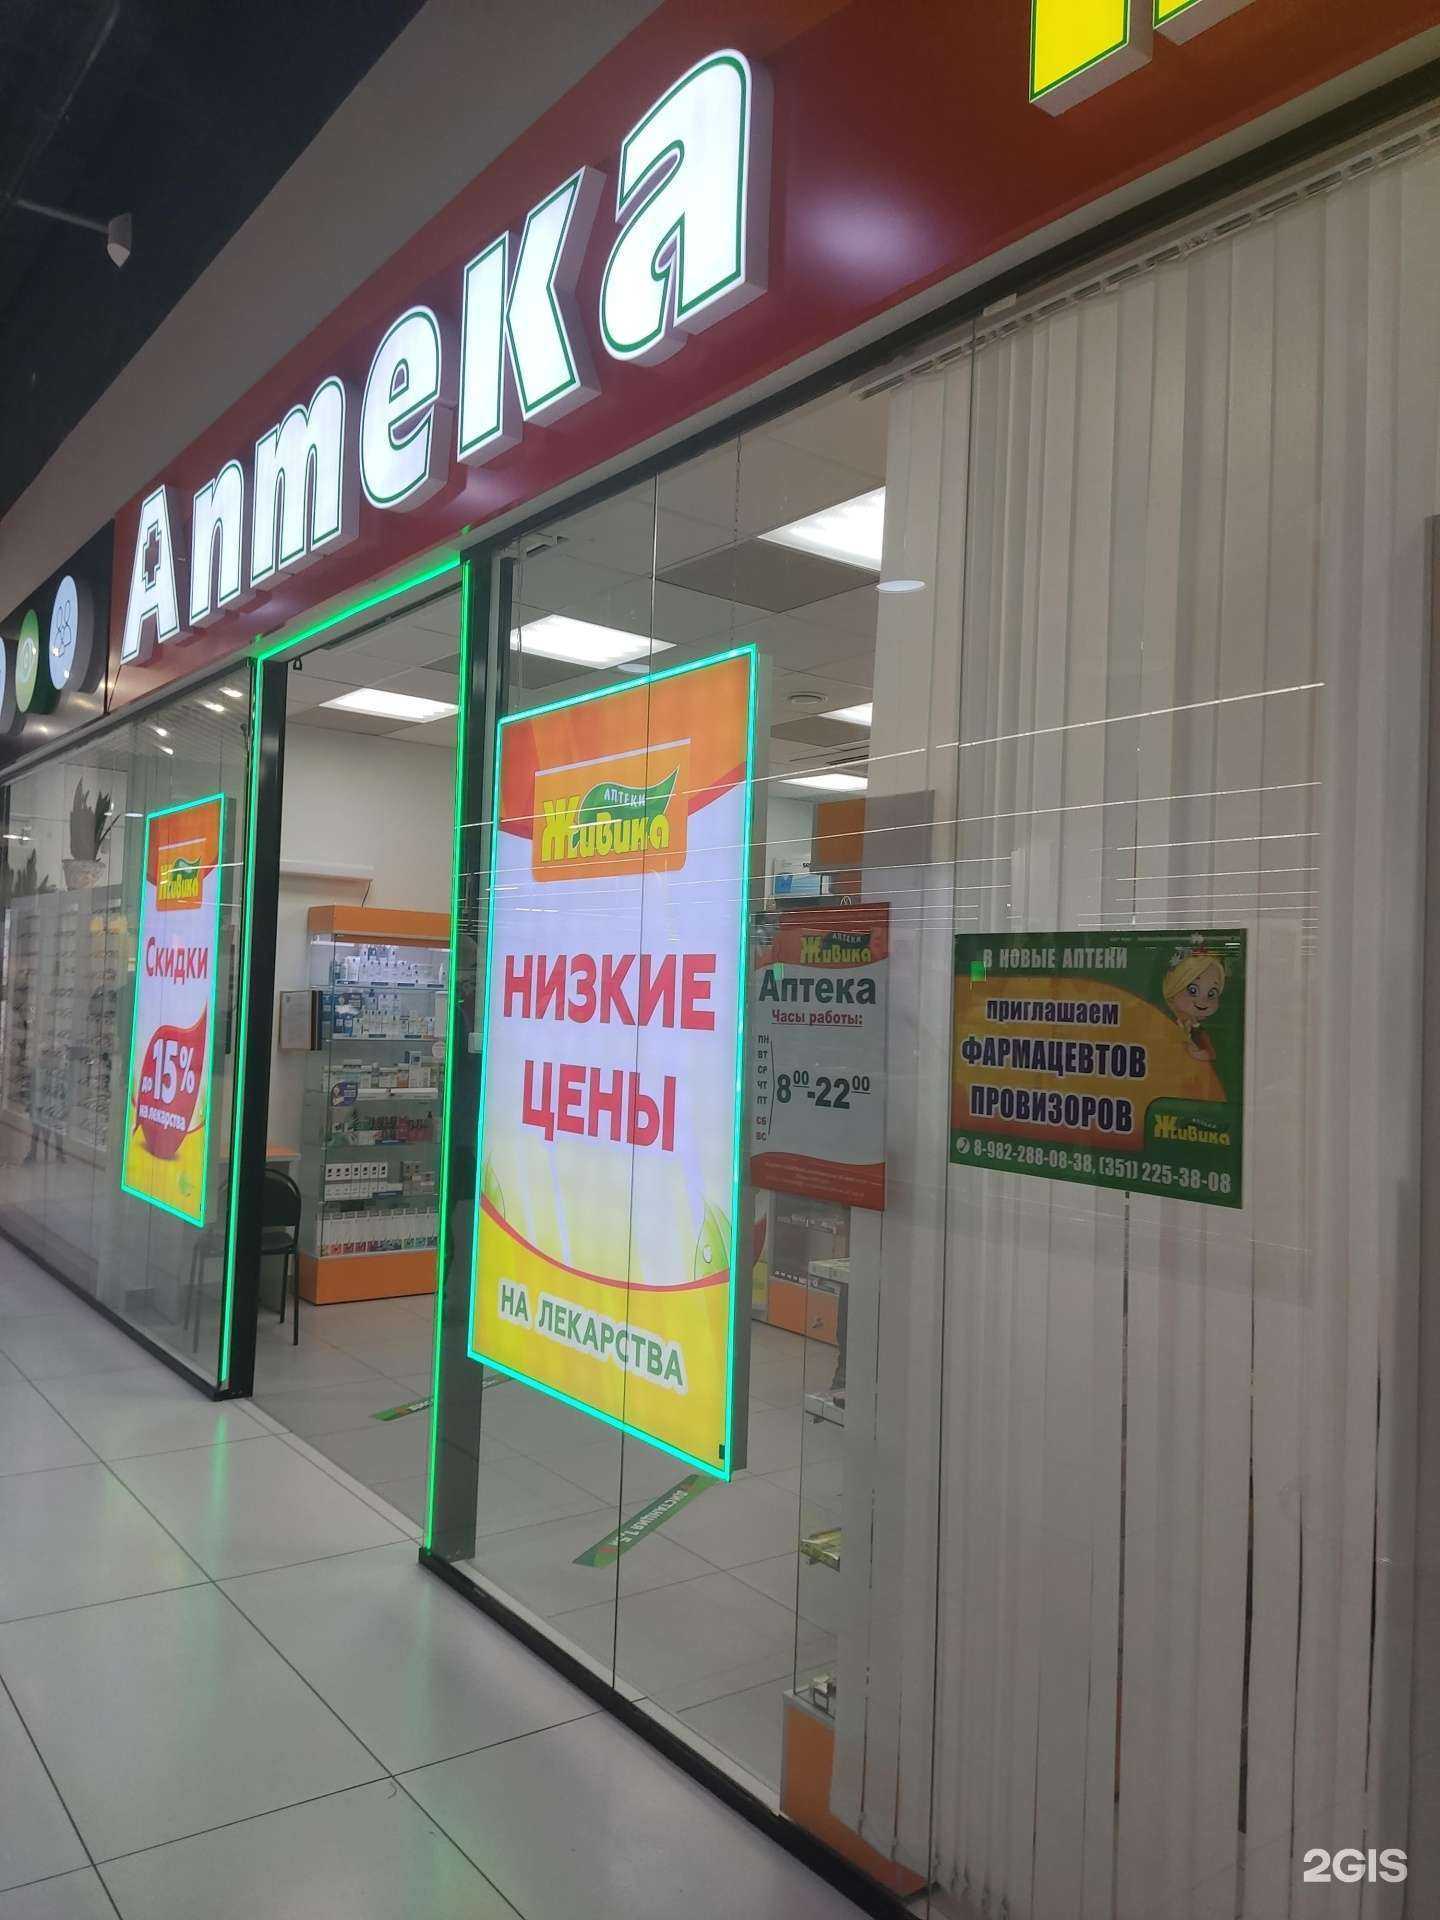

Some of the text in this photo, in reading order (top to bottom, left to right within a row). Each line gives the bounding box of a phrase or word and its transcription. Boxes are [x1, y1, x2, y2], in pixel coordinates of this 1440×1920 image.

[120, 48, 756, 666] Аптека
[146, 936, 208, 985] Скидки
[1000, 948, 1055, 969] НОВЫЕ
[1062, 948, 1128, 969] АПТЕКИ
[503, 953, 716, 1031] НИЗКИЕ
[759, 969, 876, 1004] Аптека
[772, 1009, 863, 1026] Часы работы:
[986, 999, 1120, 1025] приглашаем
[153, 1038, 195, 1105] 15%
[961, 1036, 1147, 1078] ФАРМАЦЕВТОВ
[522, 1060, 676, 1152] ЦЕНЫ
[971, 1085, 1133, 1132] ПРОВИЗОРОВ
[1141, 1161, 1231, 1194] 225-38-08
[501, 1284, 683, 1386] НА ЛЕКАРСТВА
